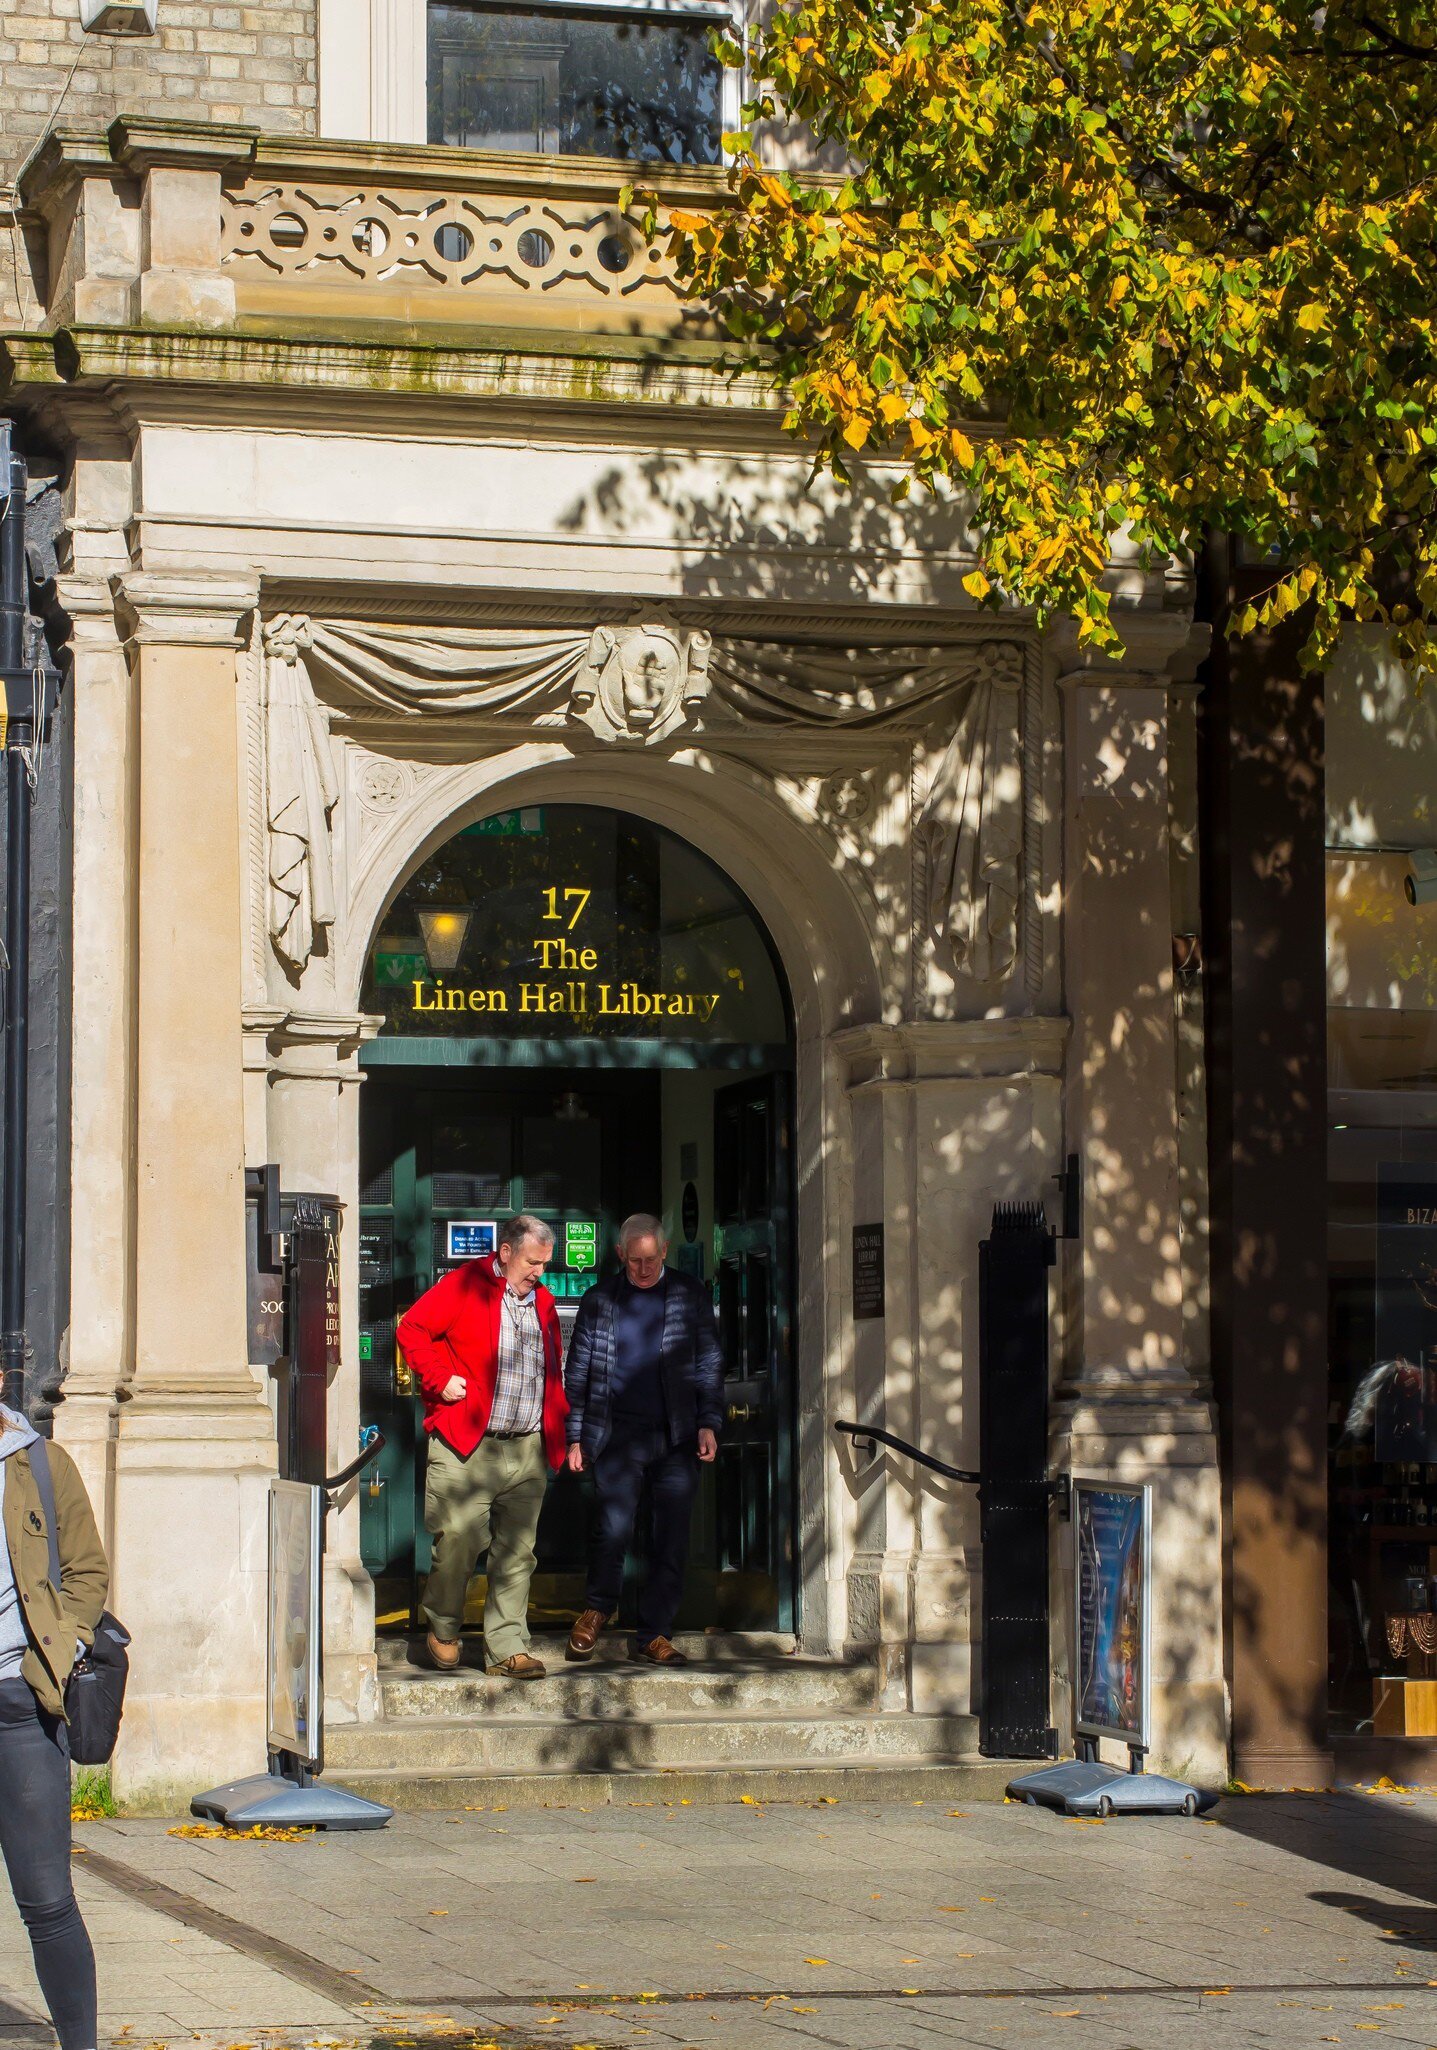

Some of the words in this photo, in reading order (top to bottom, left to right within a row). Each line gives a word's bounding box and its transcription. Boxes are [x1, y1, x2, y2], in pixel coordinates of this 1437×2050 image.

[541, 886, 591, 930] 17
[533, 938, 598, 971] The
[412, 979, 509, 1012] Linen
[518, 981, 588, 1014] Hall
[598, 983, 720, 1022] Library
